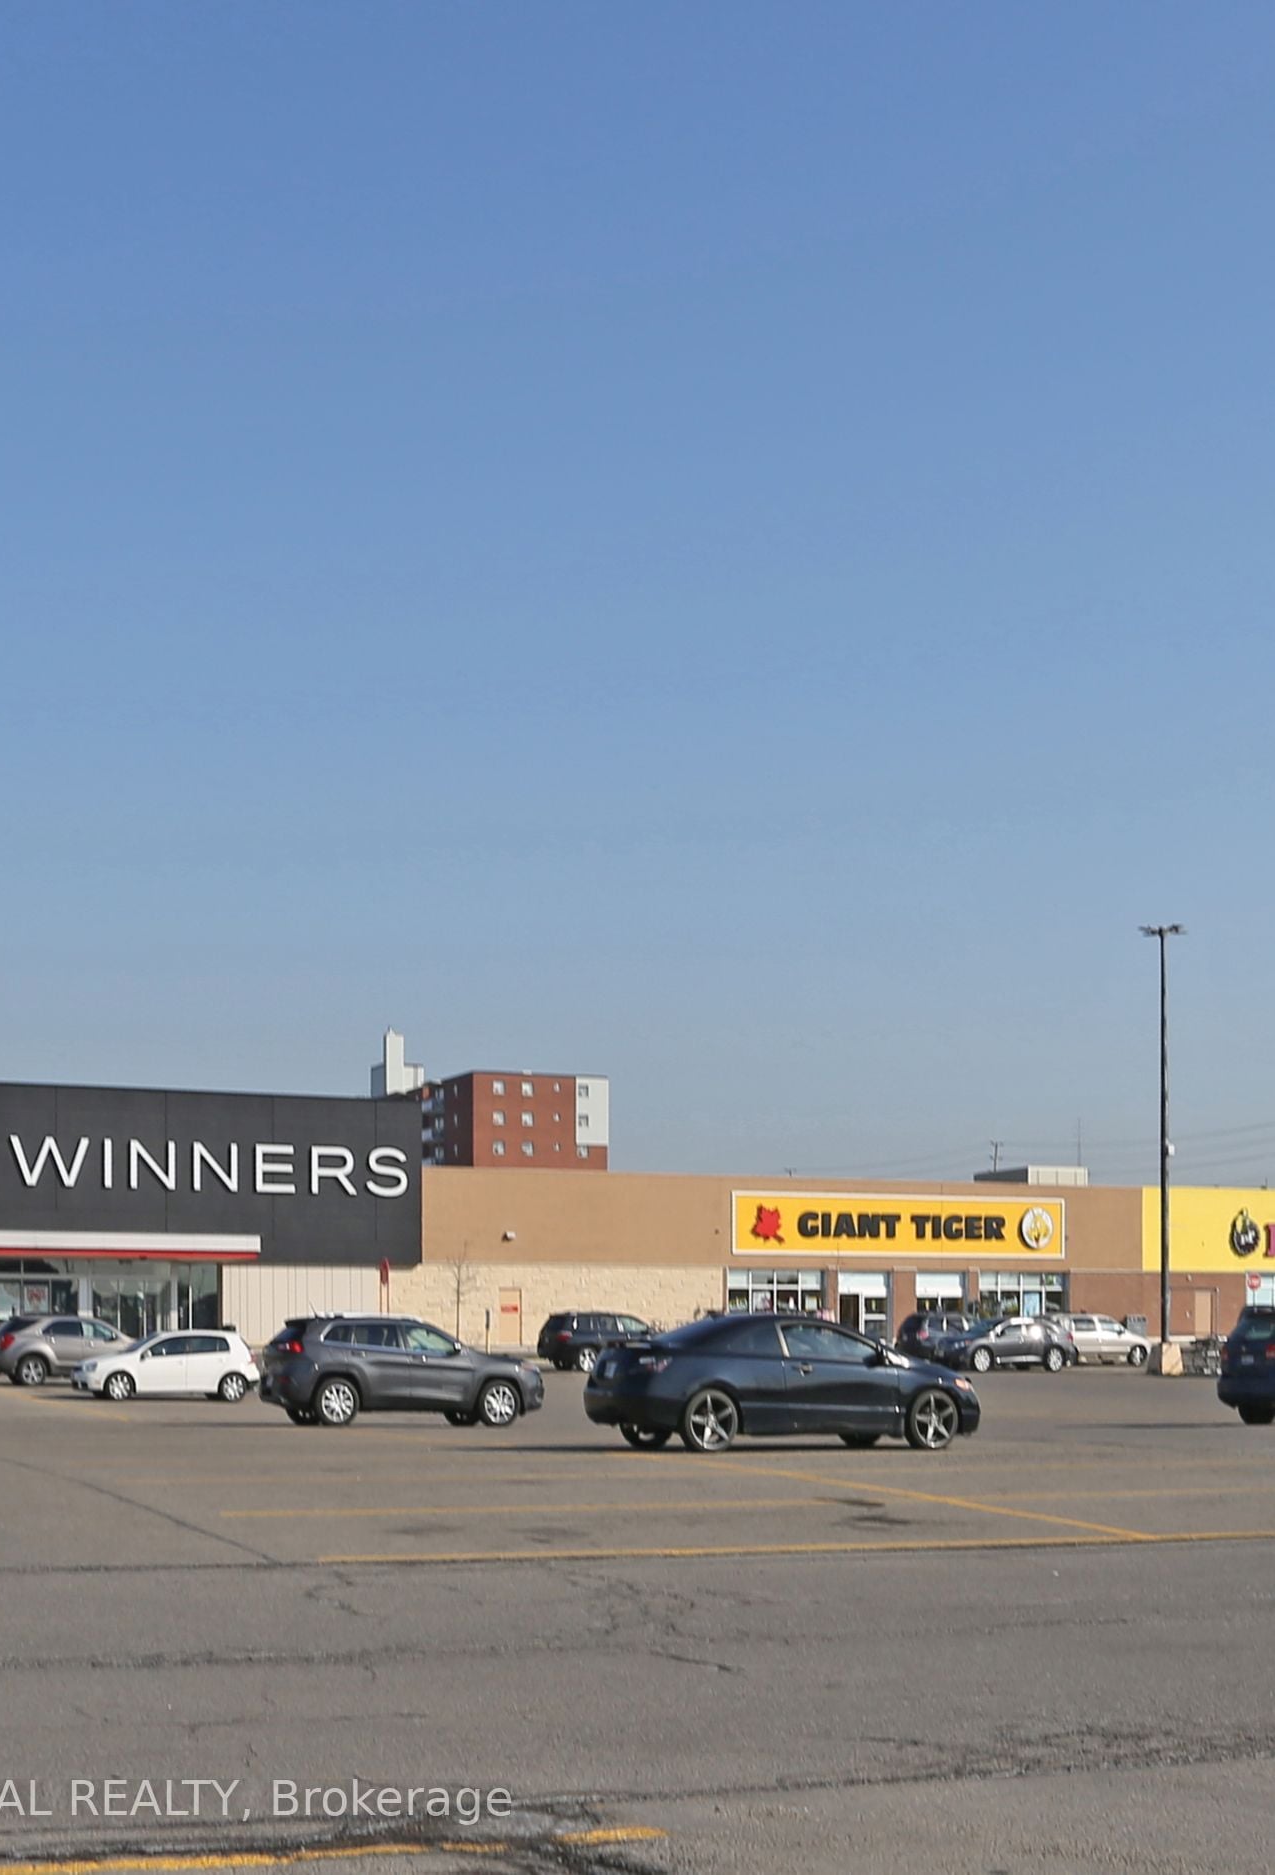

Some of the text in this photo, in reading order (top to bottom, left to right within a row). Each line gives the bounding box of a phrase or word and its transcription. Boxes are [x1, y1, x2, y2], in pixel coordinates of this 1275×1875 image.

[9, 1134, 410, 1198] WINNERS
[797, 1211, 1006, 1241] GIANT TIGER
